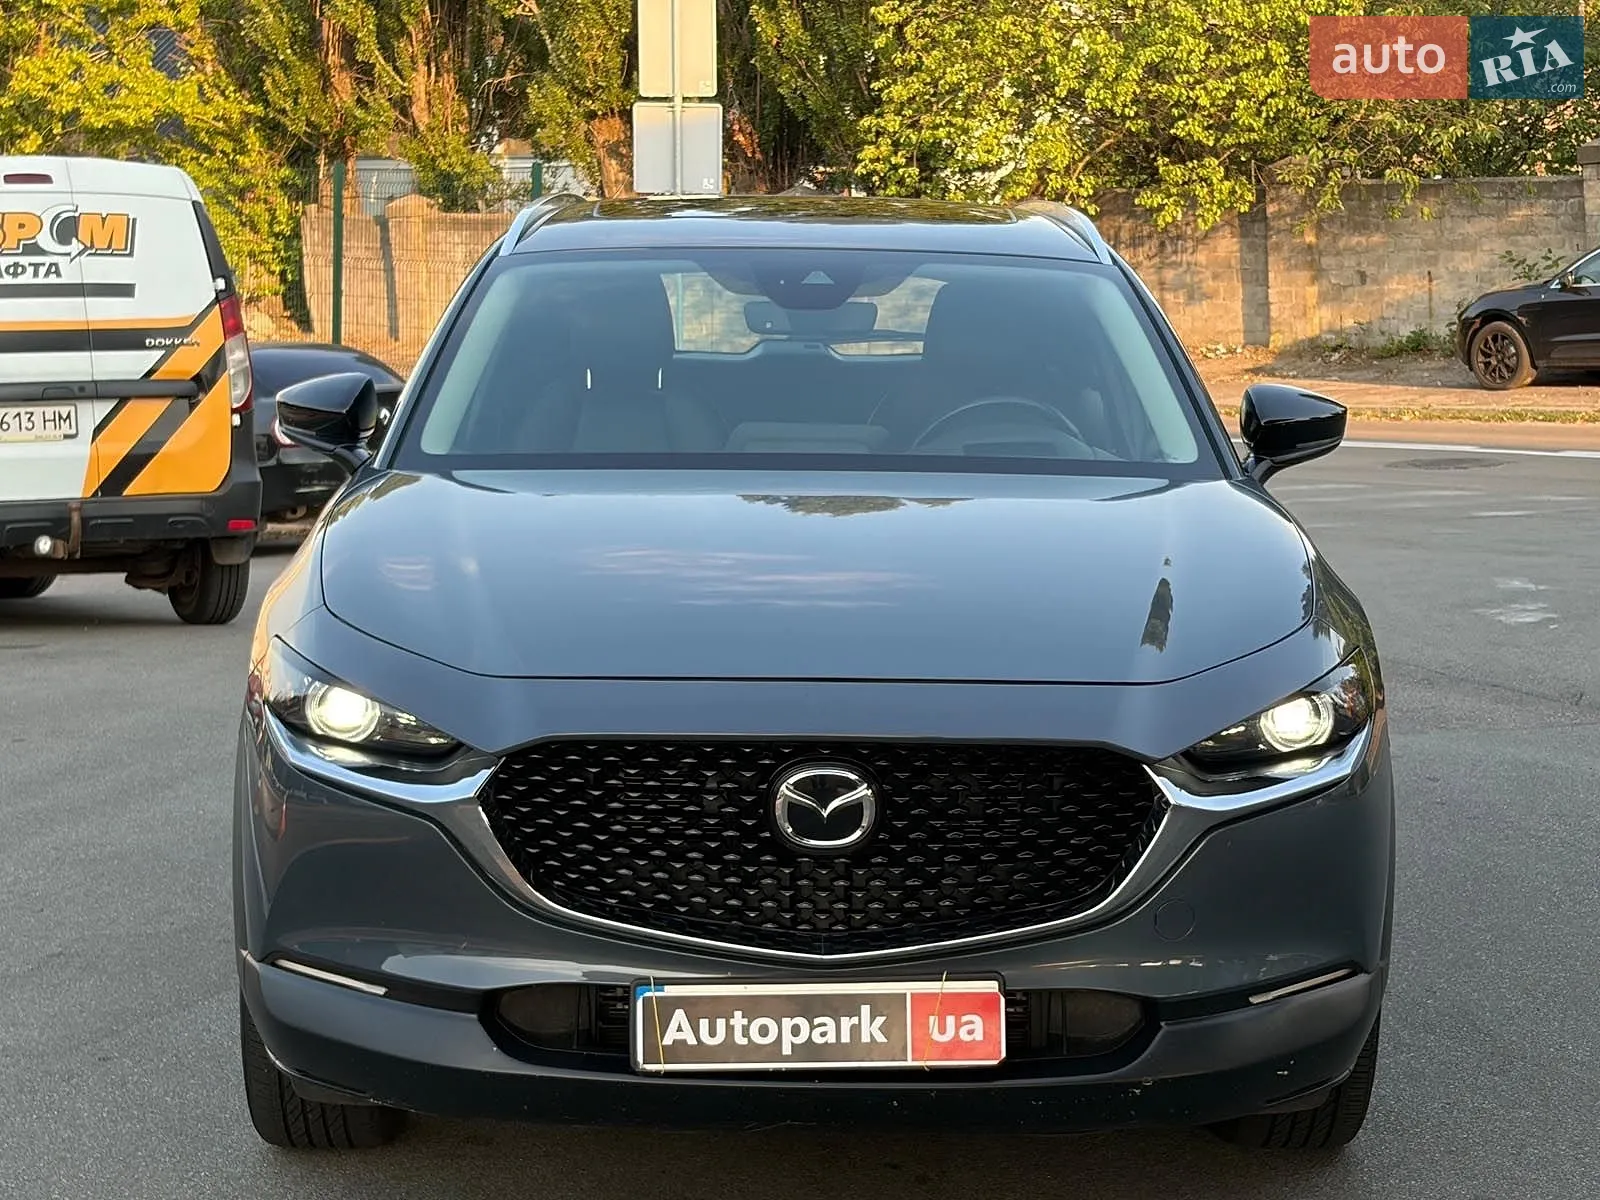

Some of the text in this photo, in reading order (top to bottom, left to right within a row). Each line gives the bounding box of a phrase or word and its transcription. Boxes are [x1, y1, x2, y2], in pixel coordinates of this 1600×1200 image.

[0, 262, 62, 278] ФТА
[0, 410, 35, 432] 613
[661, 1004, 984, 1056] Autopark ua
